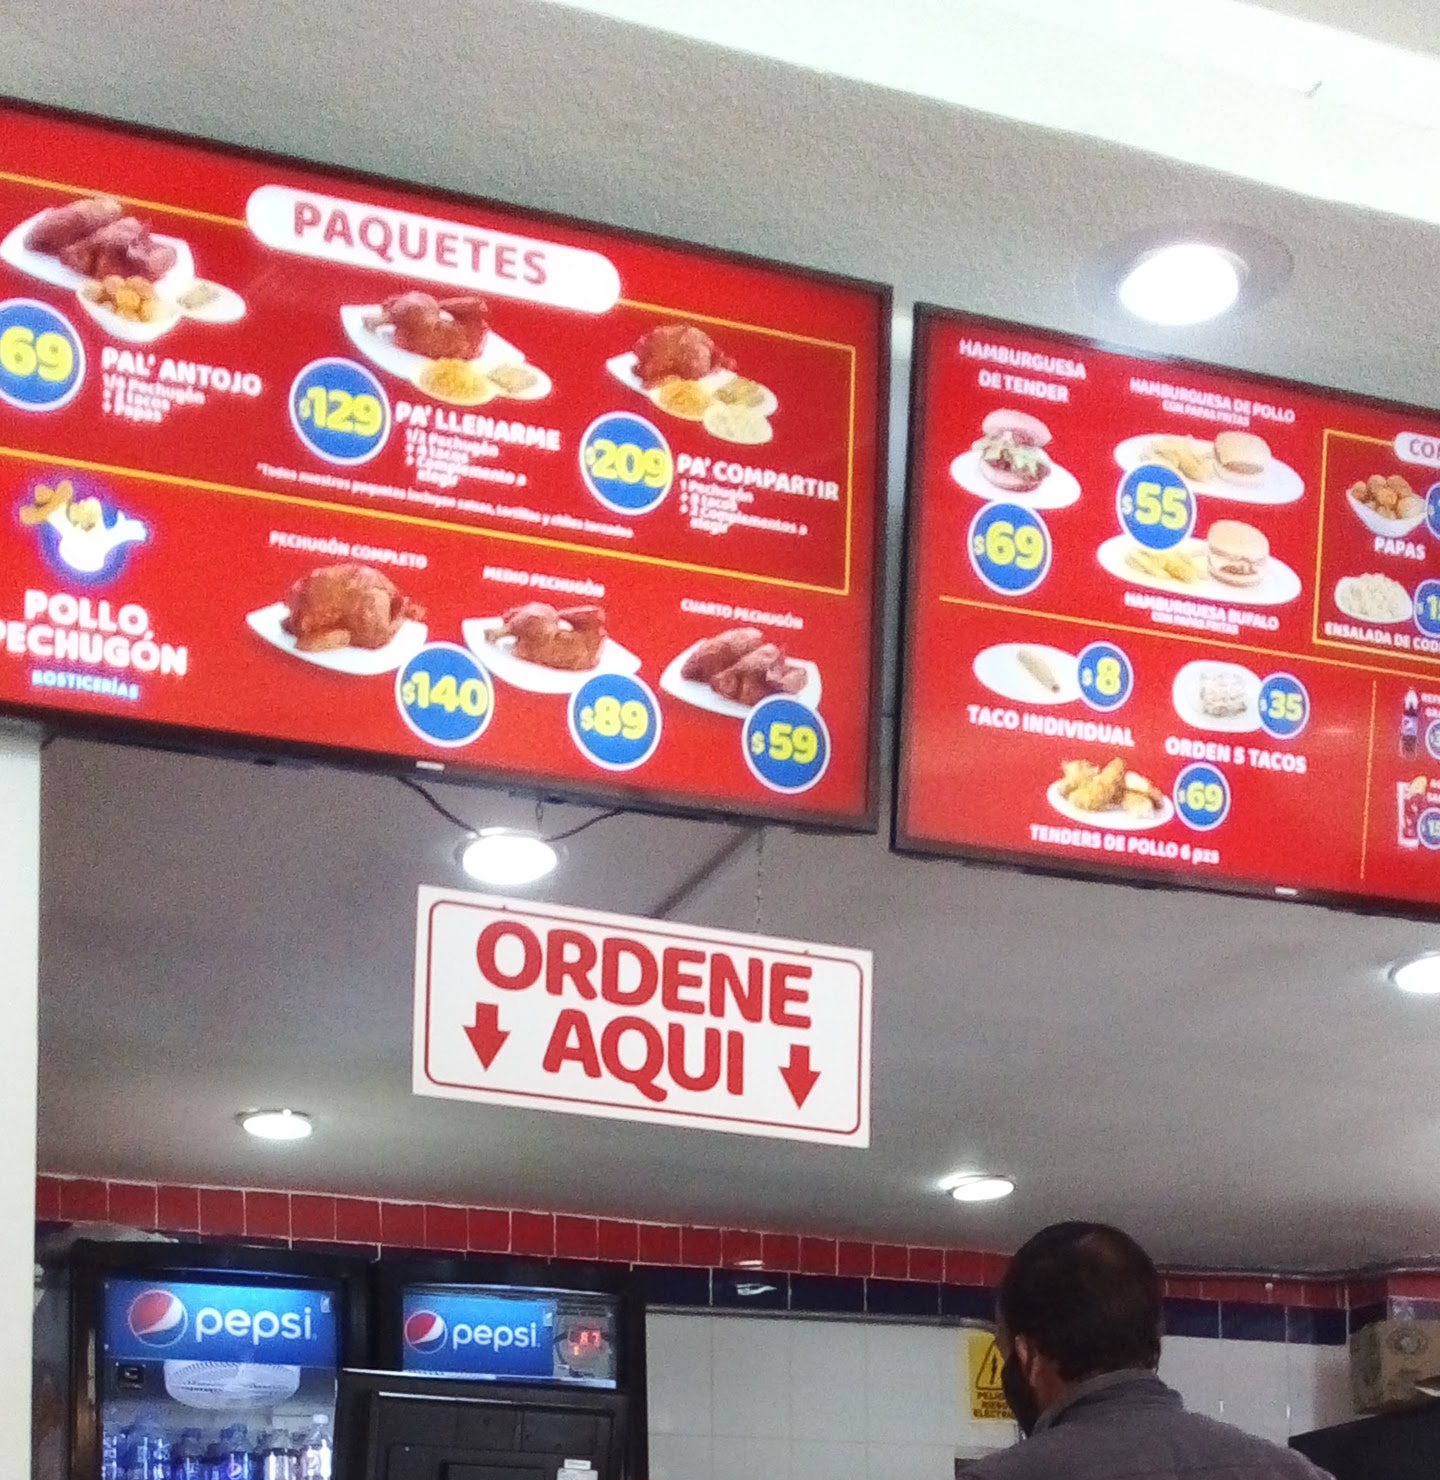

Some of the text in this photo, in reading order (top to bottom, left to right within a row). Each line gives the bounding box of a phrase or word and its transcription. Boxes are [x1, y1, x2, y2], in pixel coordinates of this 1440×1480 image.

[293, 200, 549, 287] PAQUETES
[159, 358, 262, 397] ANTOJO
[959, 336, 1087, 380] HAMBURGUESA
[977, 368, 1069, 403] DE TENDER
[1129, 376, 1296, 425] HAMBURGUESA DE POLLO
[299, 386, 382, 439] $129
[435, 408, 561, 452] LLENARME
[584, 438, 668, 490] $209
[713, 460, 839, 501] COMPARTIR
[1121, 481, 1190, 531] $55
[269, 530, 428, 570] PECHUGÓN COMPLETO
[974, 520, 1044, 571] $69
[1373, 536, 1427, 561] PAPAS
[482, 566, 605, 599] MEDIO PECHUGÓN
[680, 598, 804, 630] CUARTO PECHUGÓN
[1124, 591, 1280, 632] HAMBURGUESA BUFALO
[0, 618, 189, 677] ECHUGÓN
[1323, 620, 1393, 646] ENSALADA
[1393, 632, 1411, 650] DE
[31, 669, 140, 701] ROSTICERÍAS
[402, 671, 488, 718] $140
[1081, 656, 1122, 698] $8
[580, 696, 649, 741] $89
[967, 703, 1136, 749] TACO INDIVIDUAL
[1259, 694, 1302, 723] $35
[750, 723, 819, 765] $59
[1164, 736, 1231, 765] ORDEN
[1247, 746, 1308, 775] TACOS
[1178, 780, 1224, 814] $69
[1029, 823, 1220, 867] TENDERS DE POLLO 6 pzs
[476, 921, 813, 1030] ORDENE
[542, 1008, 745, 1102] AQUI
[195, 1306, 312, 1346] pepsi
[452, 1322, 536, 1350] pepsi
